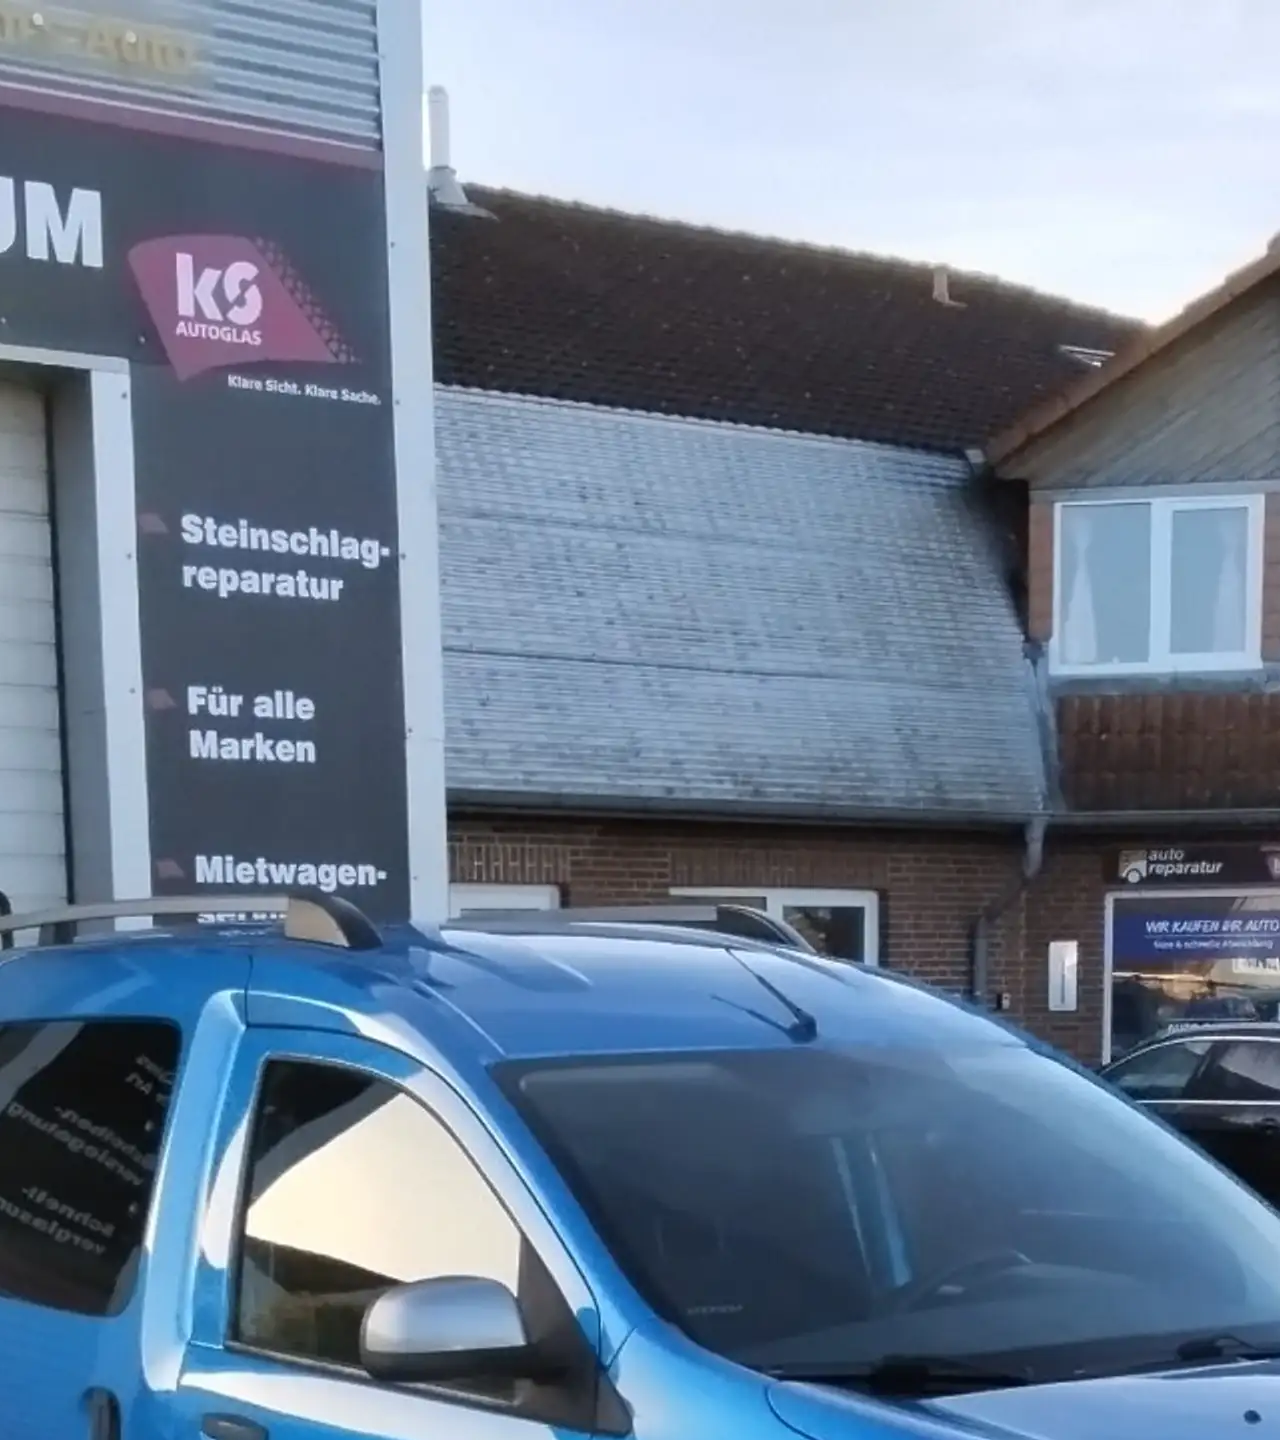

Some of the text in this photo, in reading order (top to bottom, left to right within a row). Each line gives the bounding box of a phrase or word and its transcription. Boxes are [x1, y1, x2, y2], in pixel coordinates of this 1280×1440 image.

[176, 320, 262, 346] AUTOGLAS
[228, 374, 381, 405] Klare Sicht. Klare Sache.
[181, 513, 390, 569] Steinschlag-
[182, 565, 344, 600] reparatur
[187, 685, 315, 720] Für alle
[189, 729, 316, 763] Marken
[1147, 861, 1224, 876] reparatur
[1148, 848, 1185, 861] auto
[195, 855, 387, 892] Mietwagen-
[1146, 919, 1280, 933] WIR KAUFEN IHR AUTO
